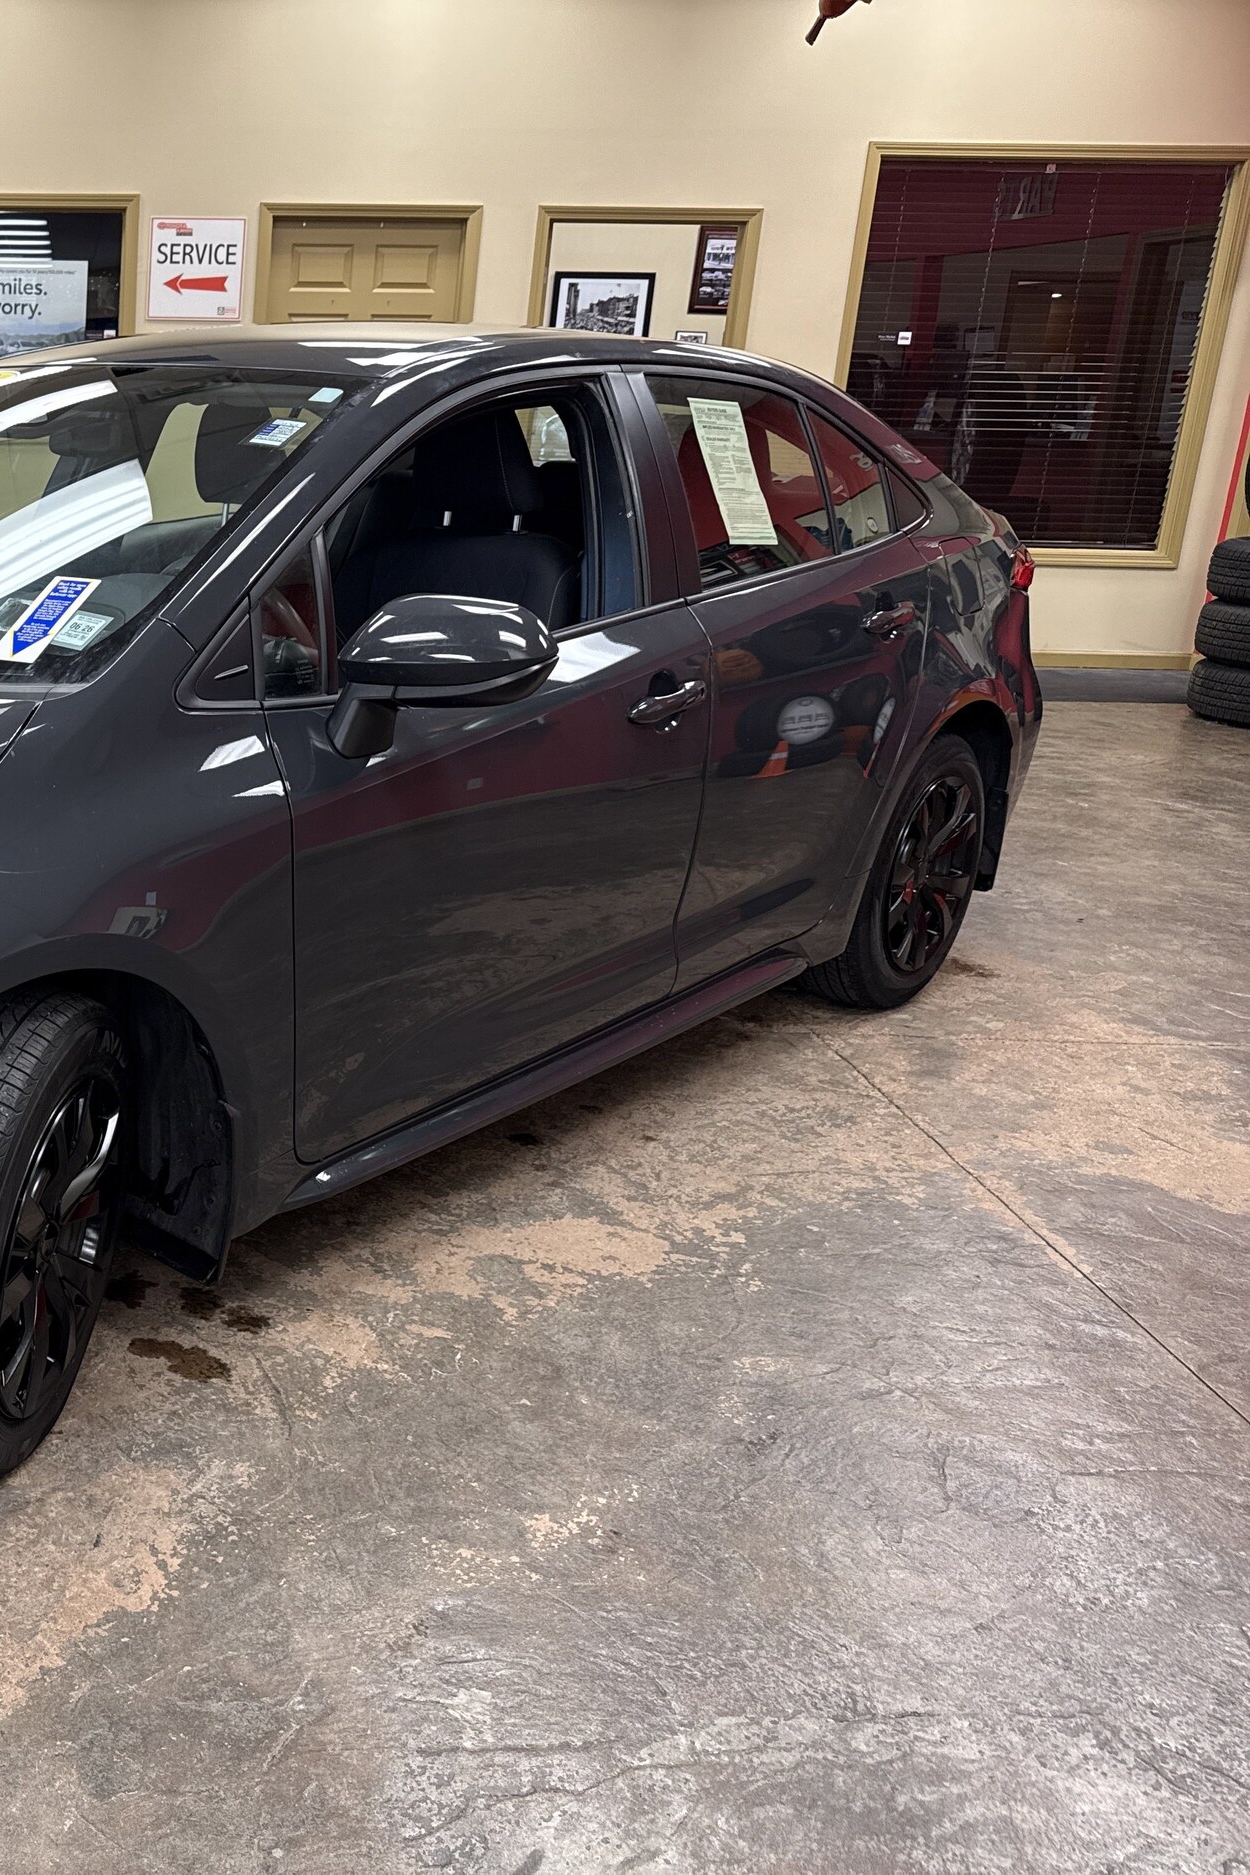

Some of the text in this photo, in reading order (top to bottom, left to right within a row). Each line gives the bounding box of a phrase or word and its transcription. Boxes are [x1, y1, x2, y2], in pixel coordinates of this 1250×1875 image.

[157, 243, 237, 265] SERVICE
[70, 622, 95, 632] 06 26
